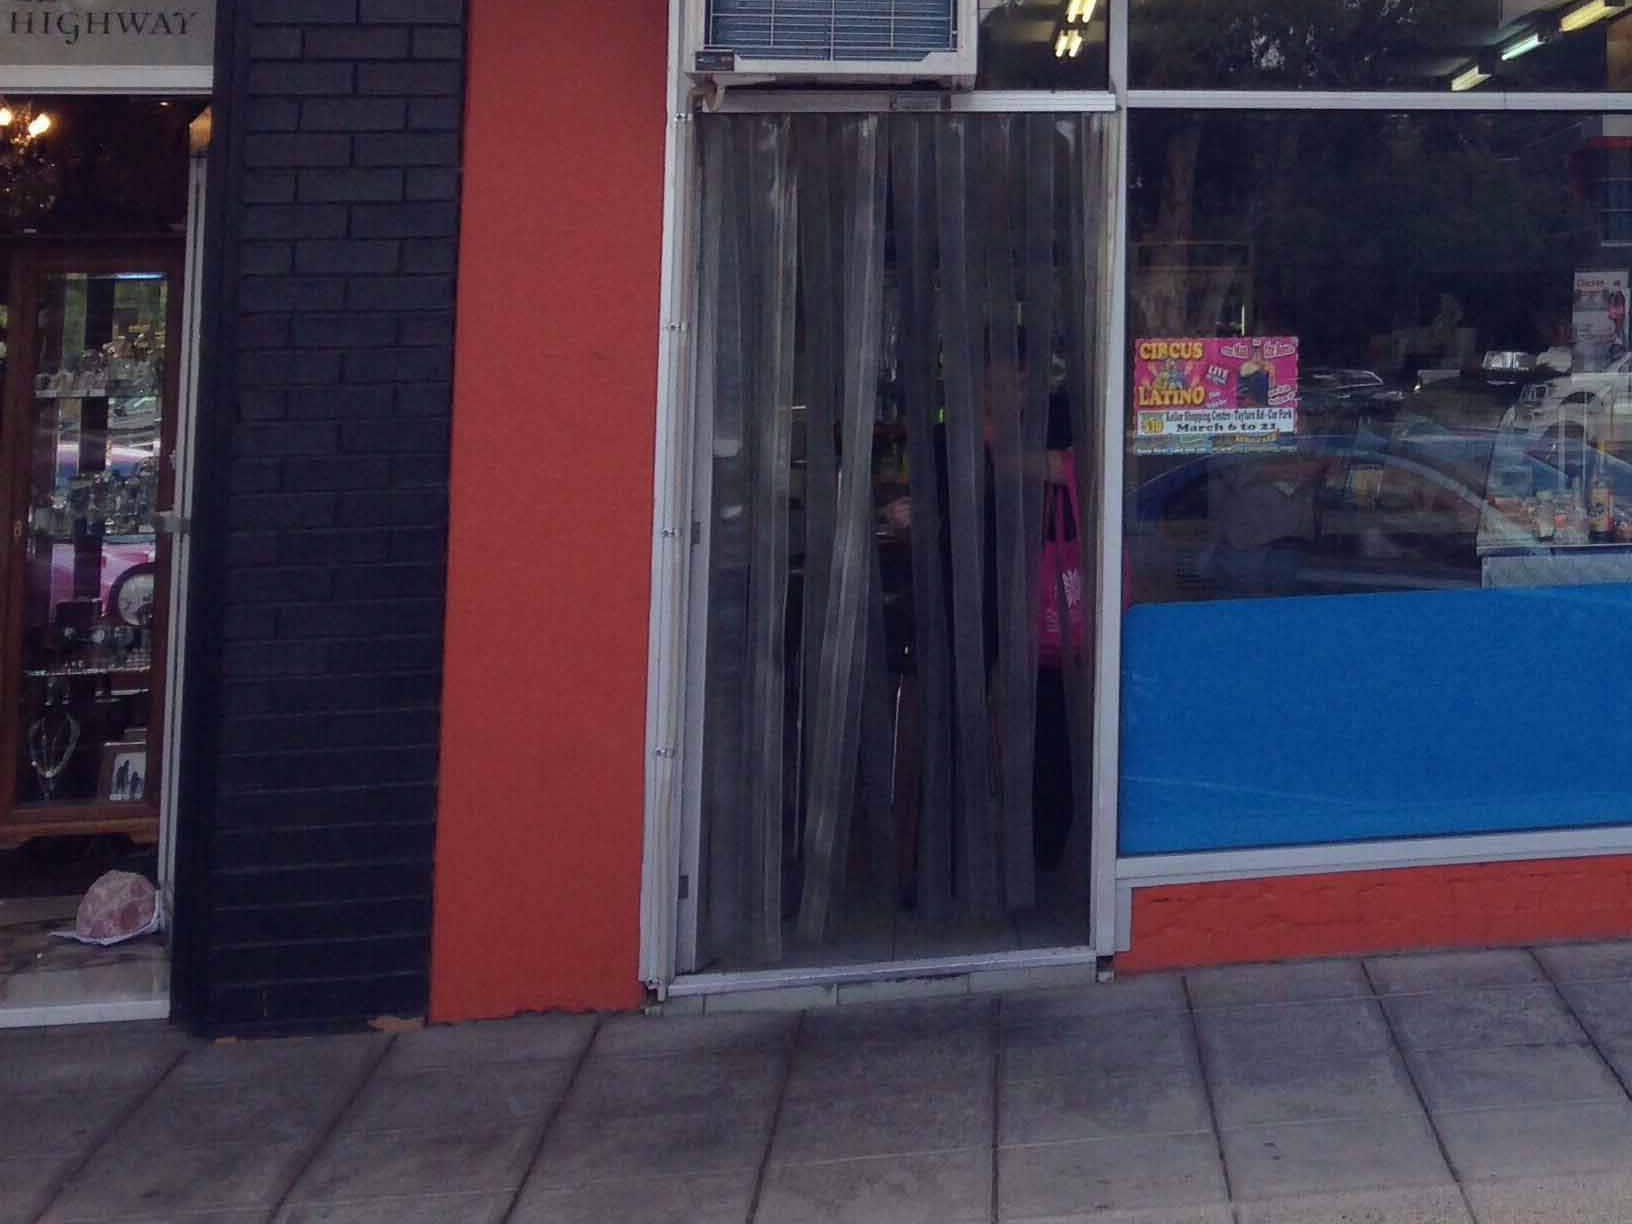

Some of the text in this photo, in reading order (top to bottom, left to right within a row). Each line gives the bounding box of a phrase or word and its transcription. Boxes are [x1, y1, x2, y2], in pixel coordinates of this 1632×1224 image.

[9, 10, 200, 46] HIGHWAY
[1139, 342, 1205, 361] CIRCUS
[1138, 384, 1206, 407] LATINO
[1176, 422, 1224, 433] March
[1240, 422, 1256, 431] to
